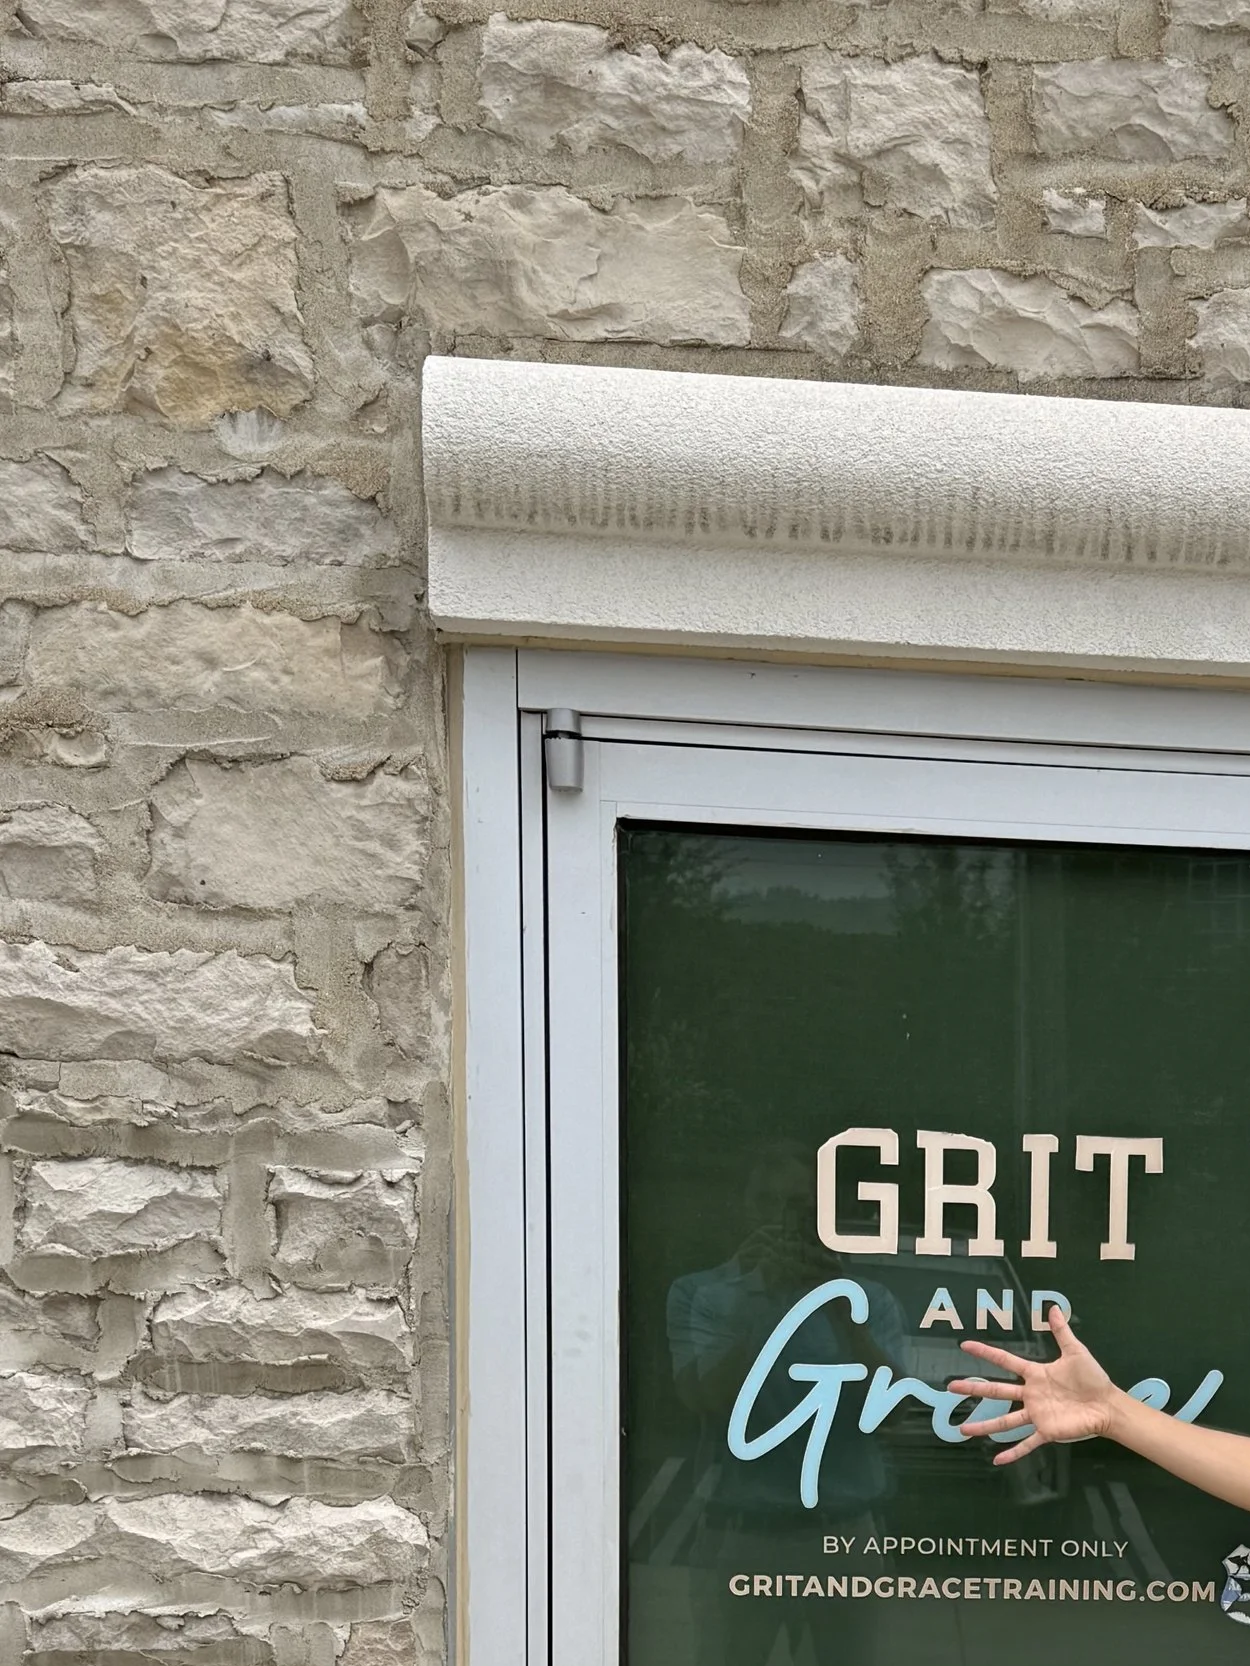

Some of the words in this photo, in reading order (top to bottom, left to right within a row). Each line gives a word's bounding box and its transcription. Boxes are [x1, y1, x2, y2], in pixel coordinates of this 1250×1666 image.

[817, 1128, 1165, 1261] GRIT
[919, 1287, 1072, 1332] AND
[727, 1278, 1224, 1509] Grae
[823, 1536, 856, 1555] BY
[864, 1537, 1054, 1558] APPOINTMENT
[1061, 1540, 1129, 1558] ONLY
[728, 1574, 1216, 1602] GRITANDGRACETRAINING.COM
